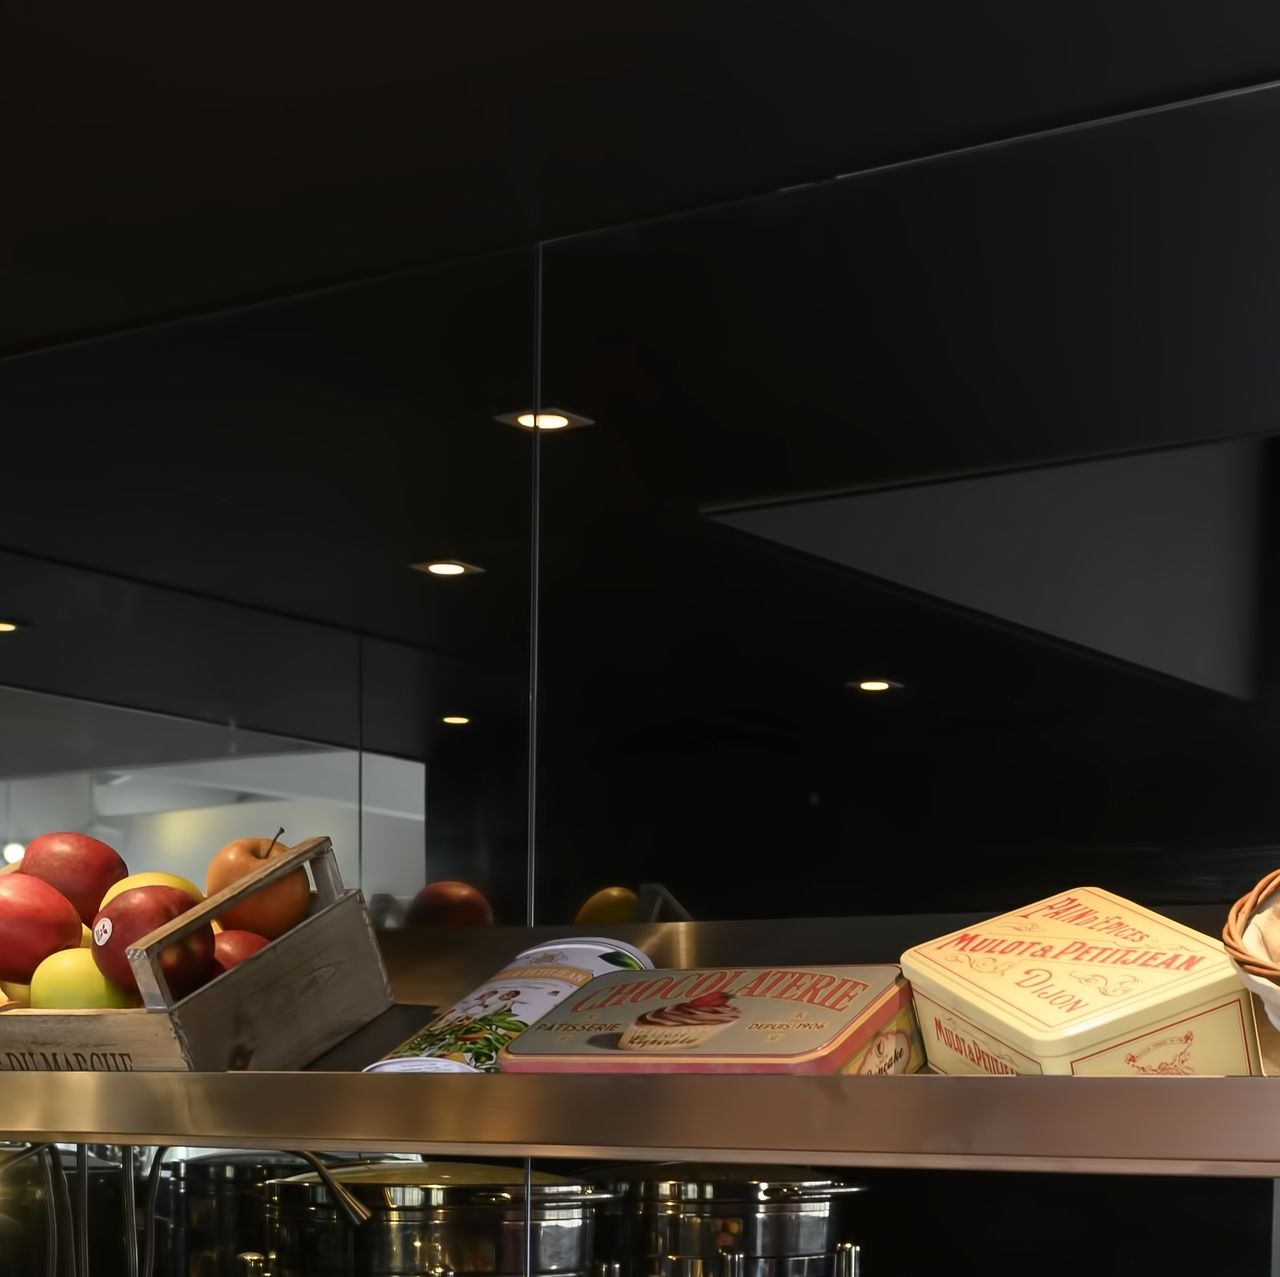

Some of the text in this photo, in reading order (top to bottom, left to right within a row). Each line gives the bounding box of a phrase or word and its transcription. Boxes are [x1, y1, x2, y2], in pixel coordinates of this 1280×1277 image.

[1054, 940, 1206, 972] PETITJEAN
[570, 969, 870, 1013] CHOCOLATERIE
[1014, 967, 1089, 1014] DIJON
